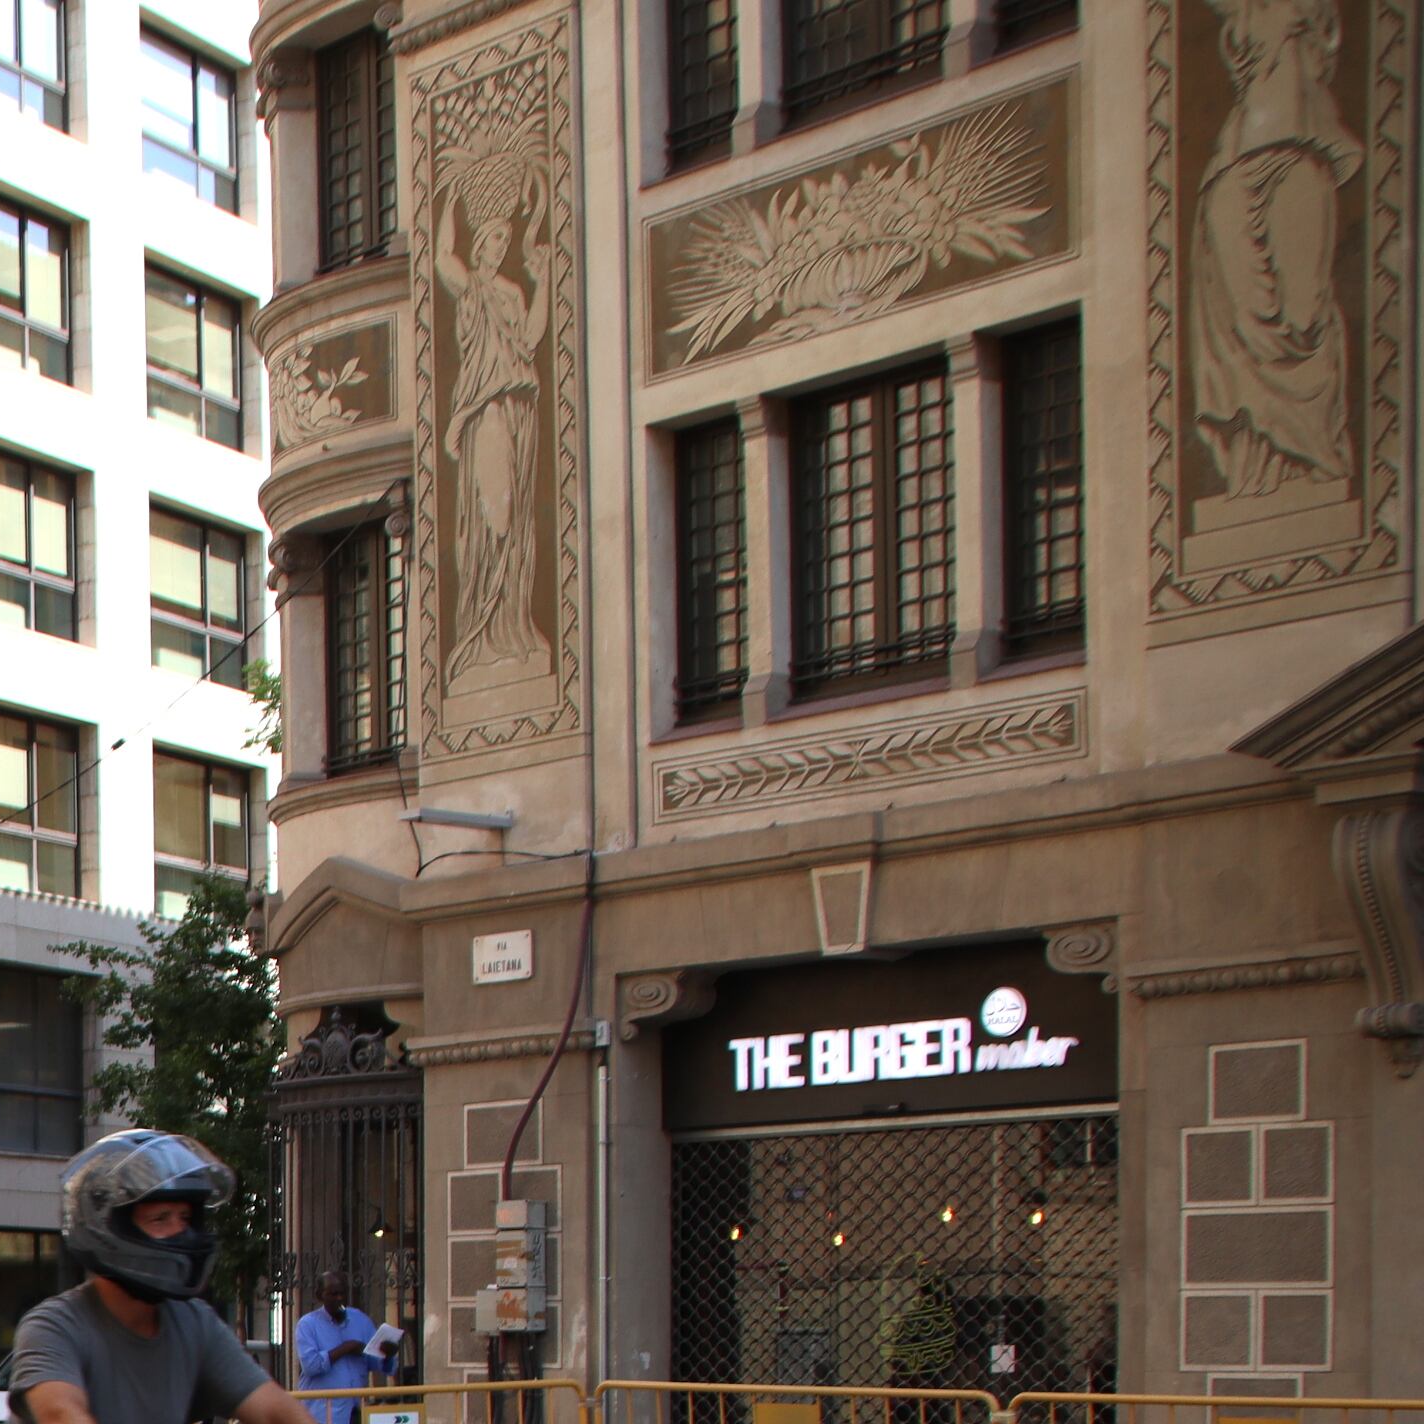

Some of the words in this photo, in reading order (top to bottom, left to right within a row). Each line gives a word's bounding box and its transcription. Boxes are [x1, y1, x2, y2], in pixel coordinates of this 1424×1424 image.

[496, 941, 508, 951] VIA
[482, 958, 522, 975] LAIETANA
[728, 1033, 805, 1092] THE
[810, 1017, 972, 1086] BURGER
